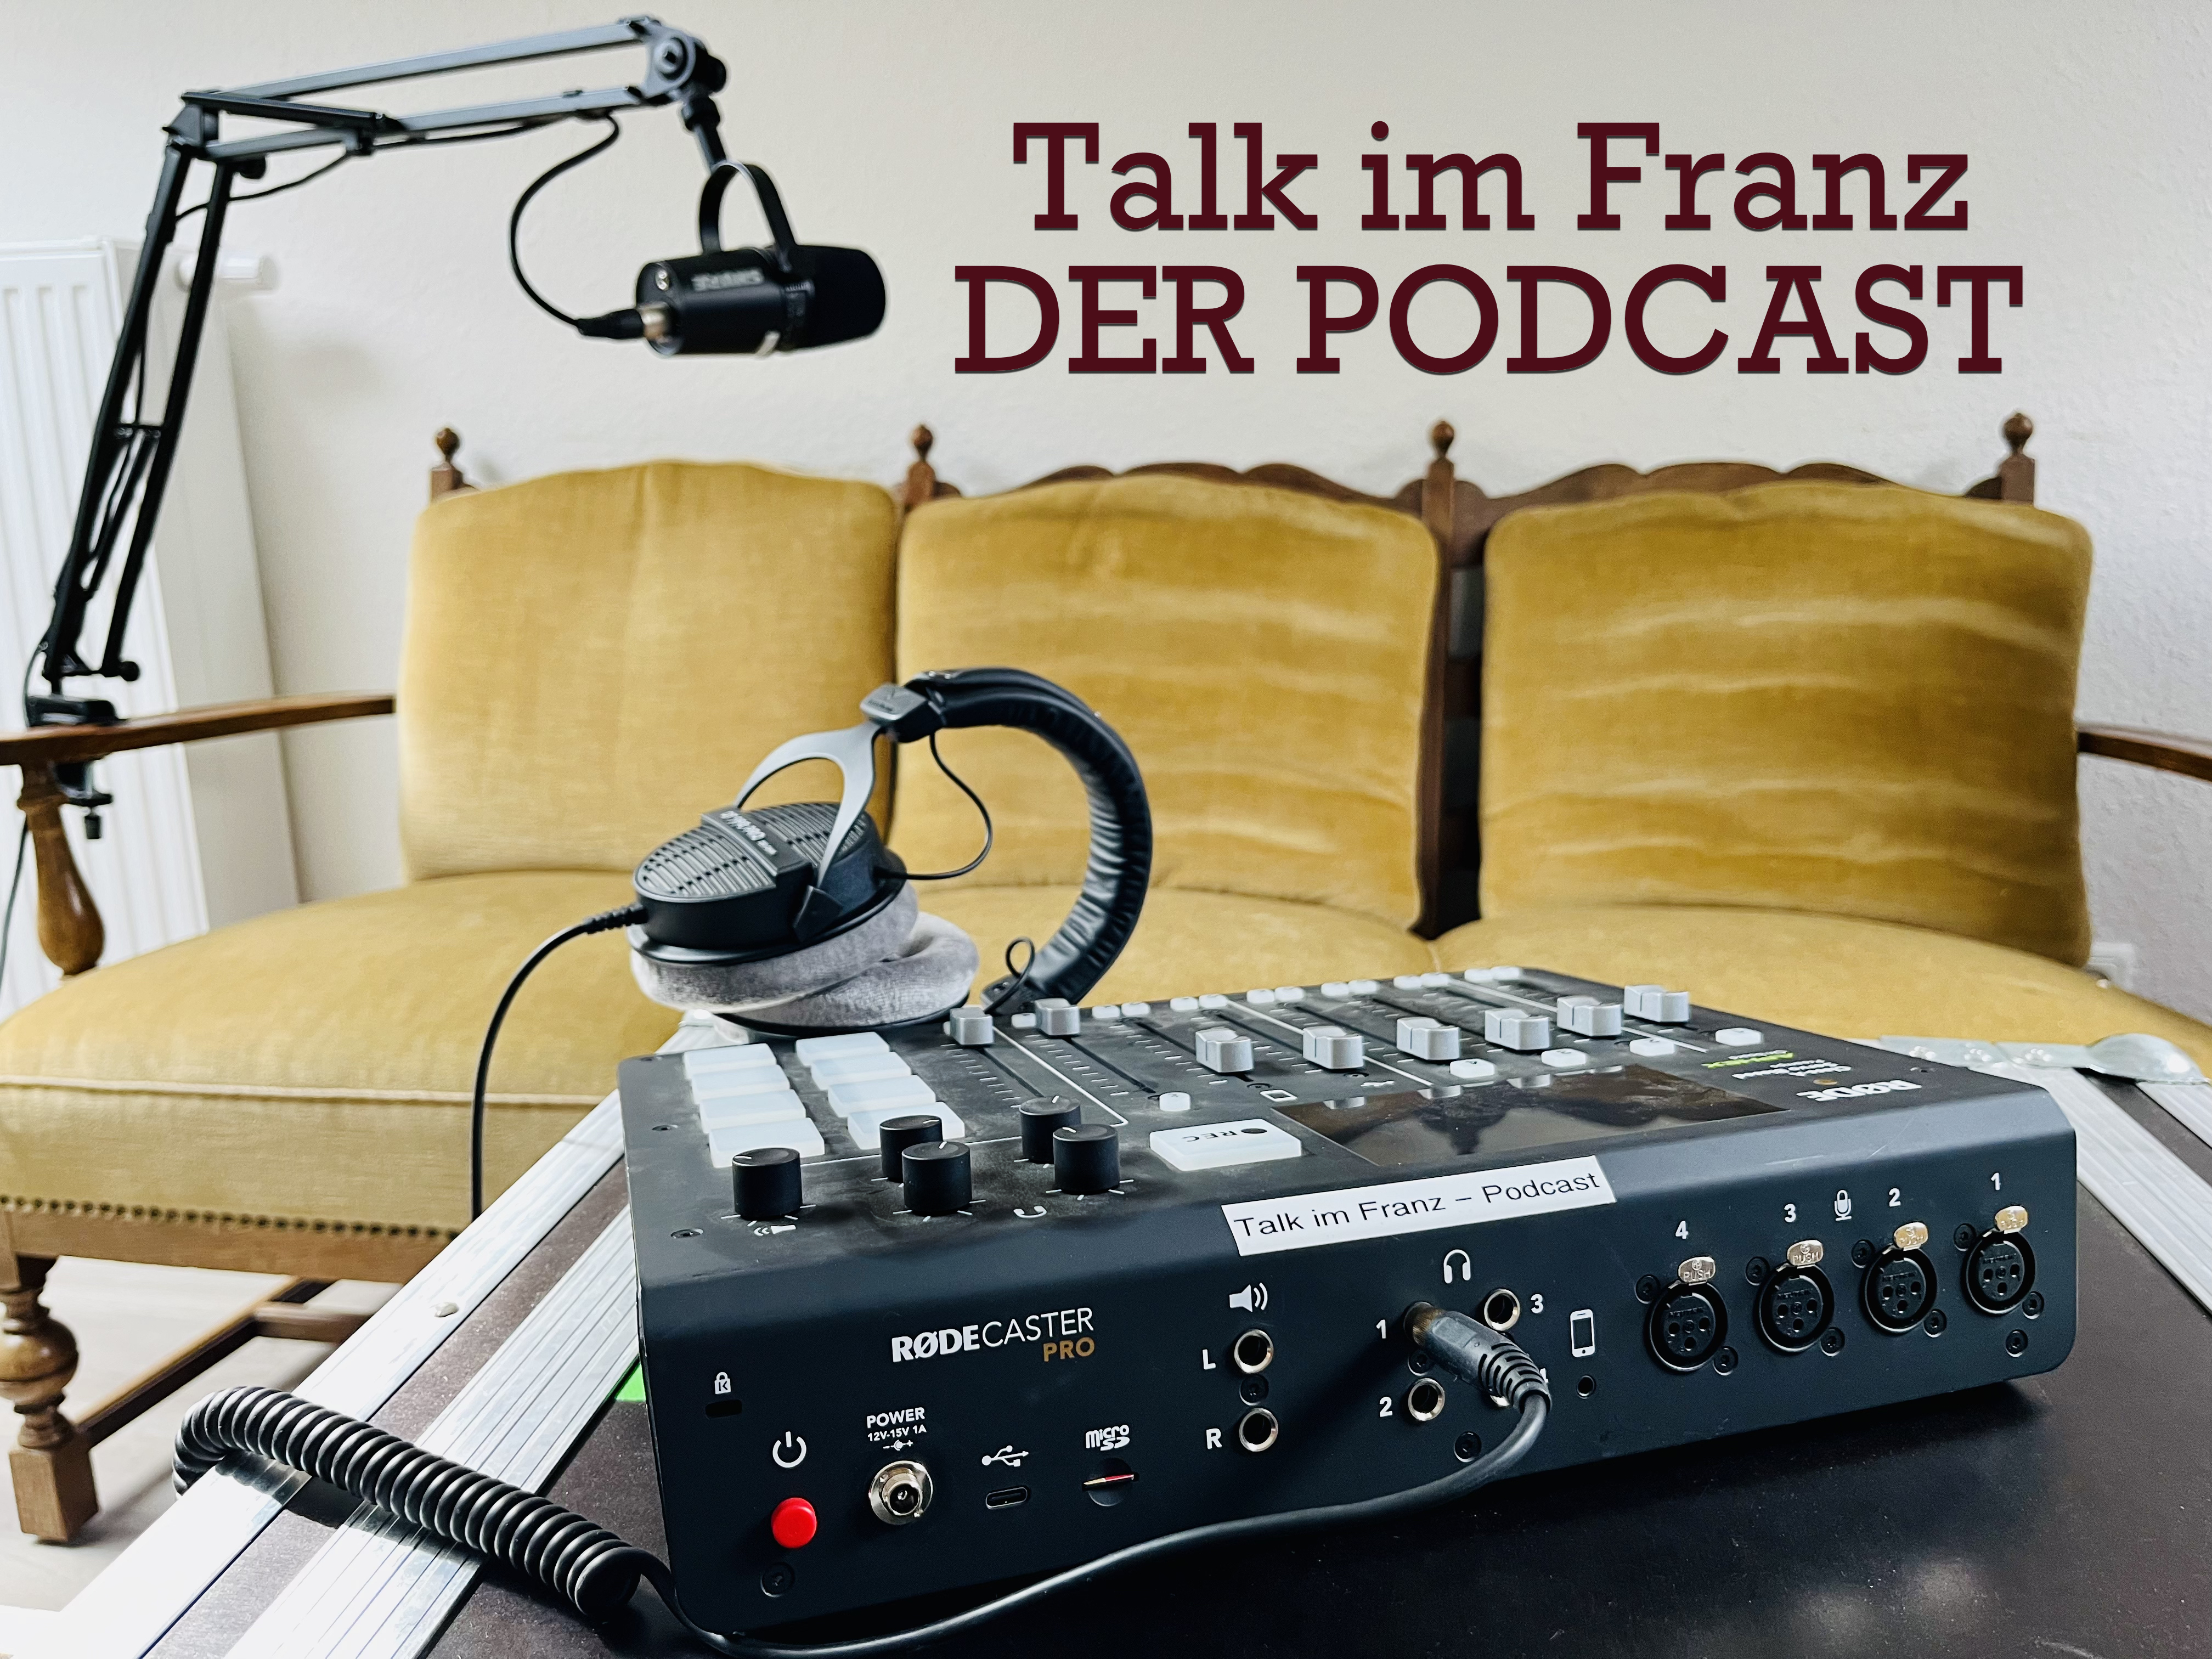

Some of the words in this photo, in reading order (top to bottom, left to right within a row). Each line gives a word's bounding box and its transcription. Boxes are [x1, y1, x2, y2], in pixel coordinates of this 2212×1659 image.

[1181, 1130, 1238, 1142] REC
[1991, 1172, 2000, 1190] 1
[1234, 1213, 1304, 1237] Talk
[1313, 1209, 1350, 1227] im
[1358, 1197, 1446, 1221] Franz
[1482, 1172, 1601, 1203] Podcast
[1889, 1188, 1901, 1207] 2
[1784, 1204, 1796, 1223] 3
[1675, 1220, 1689, 1239] 4
[1792, 1251, 1819, 1265] PUSH
[1683, 1269, 1711, 1282] PUSH
[1530, 1294, 1544, 1314] 3
[891, 1307, 1094, 1362] RØDECASTER
[1376, 1319, 1386, 1339] 1
[1044, 1336, 1095, 1362] PRO
[1202, 1349, 1216, 1370] L
[1379, 1396, 1393, 1418] 2
[866, 1407, 926, 1429] POWER
[867, 1426, 910, 1442] 12V-15V
[912, 1424, 927, 1434] 1A
[1206, 1428, 1222, 1449] R
